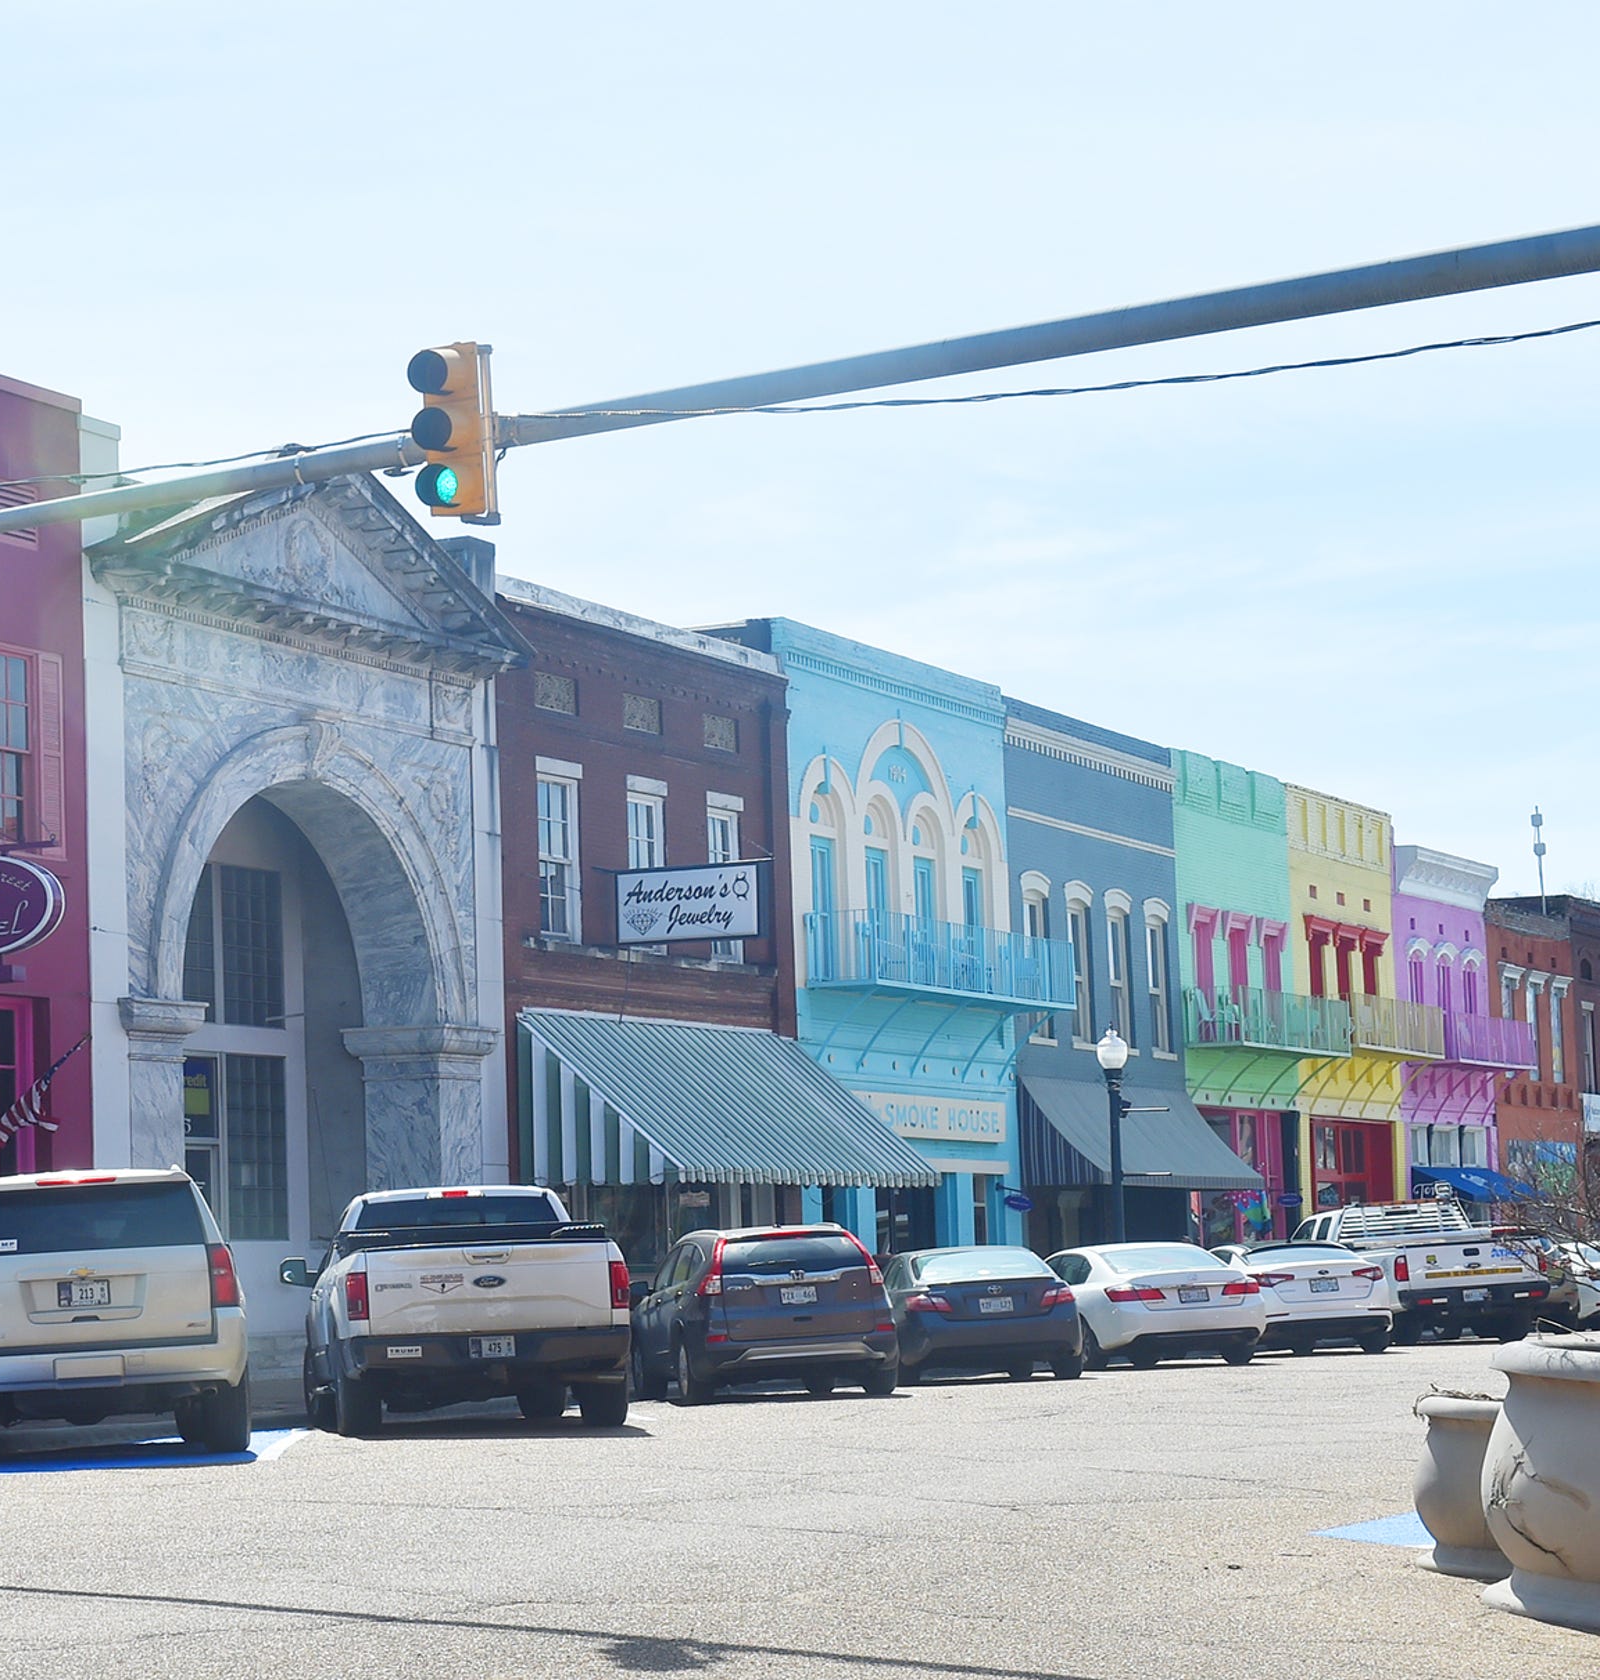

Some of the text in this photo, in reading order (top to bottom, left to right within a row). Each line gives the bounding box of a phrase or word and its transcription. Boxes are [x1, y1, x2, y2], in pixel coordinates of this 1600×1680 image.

[623, 873, 731, 906] Anderson's
[666, 903, 734, 934] Jewelry
[183, 1073, 206, 1088] redit
[885, 1103, 939, 1130] SMOKE
[947, 1108, 1000, 1134] HOUSE
[478, 1278, 499, 1287] Ford
[79, 1287, 95, 1300] 213
[488, 1341, 503, 1353] 475
